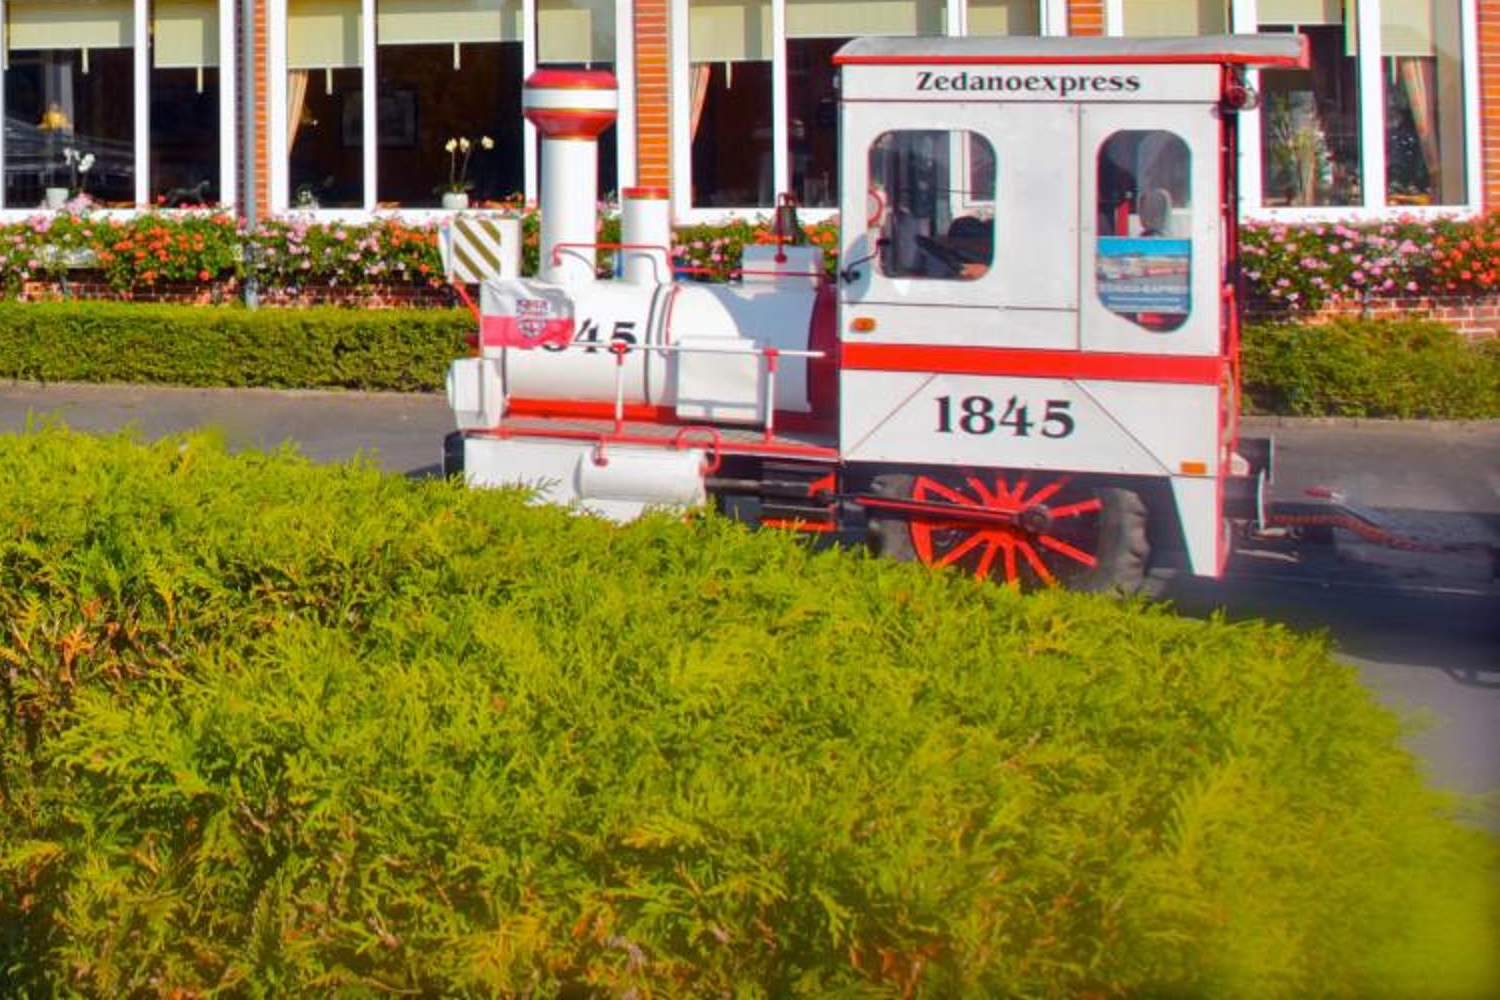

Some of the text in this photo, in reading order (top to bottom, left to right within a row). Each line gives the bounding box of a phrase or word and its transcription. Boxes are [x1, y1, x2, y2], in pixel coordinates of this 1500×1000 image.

[916, 71, 1141, 97] Zedanoexpress
[542, 317, 637, 354] 45
[933, 394, 1076, 439] 1845
